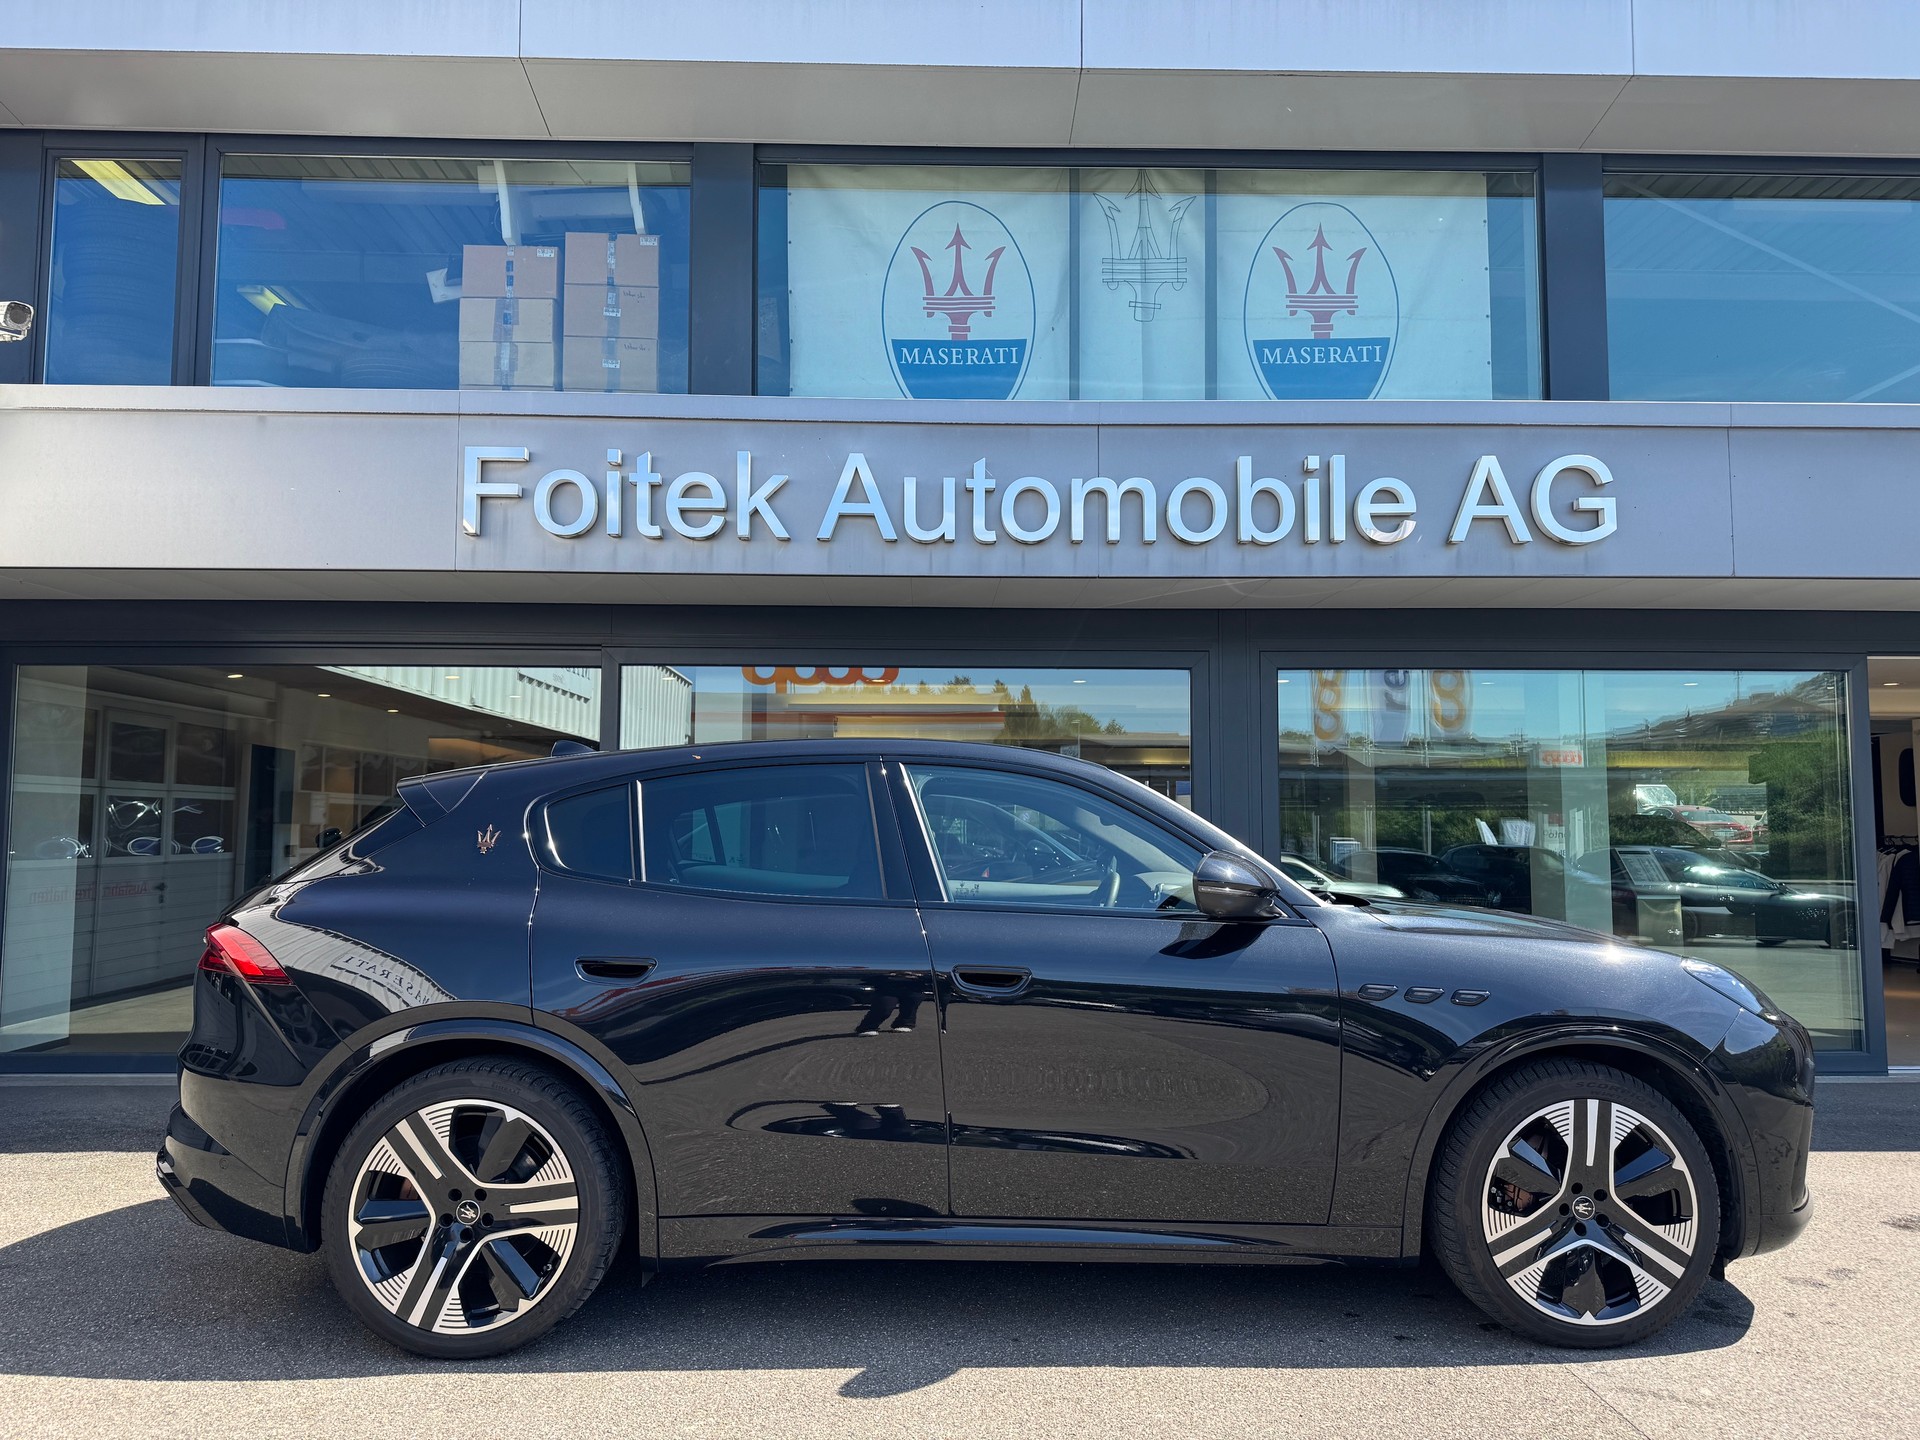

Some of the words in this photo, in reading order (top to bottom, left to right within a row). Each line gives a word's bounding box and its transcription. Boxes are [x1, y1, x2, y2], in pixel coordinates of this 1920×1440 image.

[900, 347, 1019, 366] MASERATI
[1262, 345, 1382, 365] MASERATI
[462, 446, 792, 541] Foitek
[816, 452, 1417, 546] Automobile
[1446, 453, 1618, 547] AG
